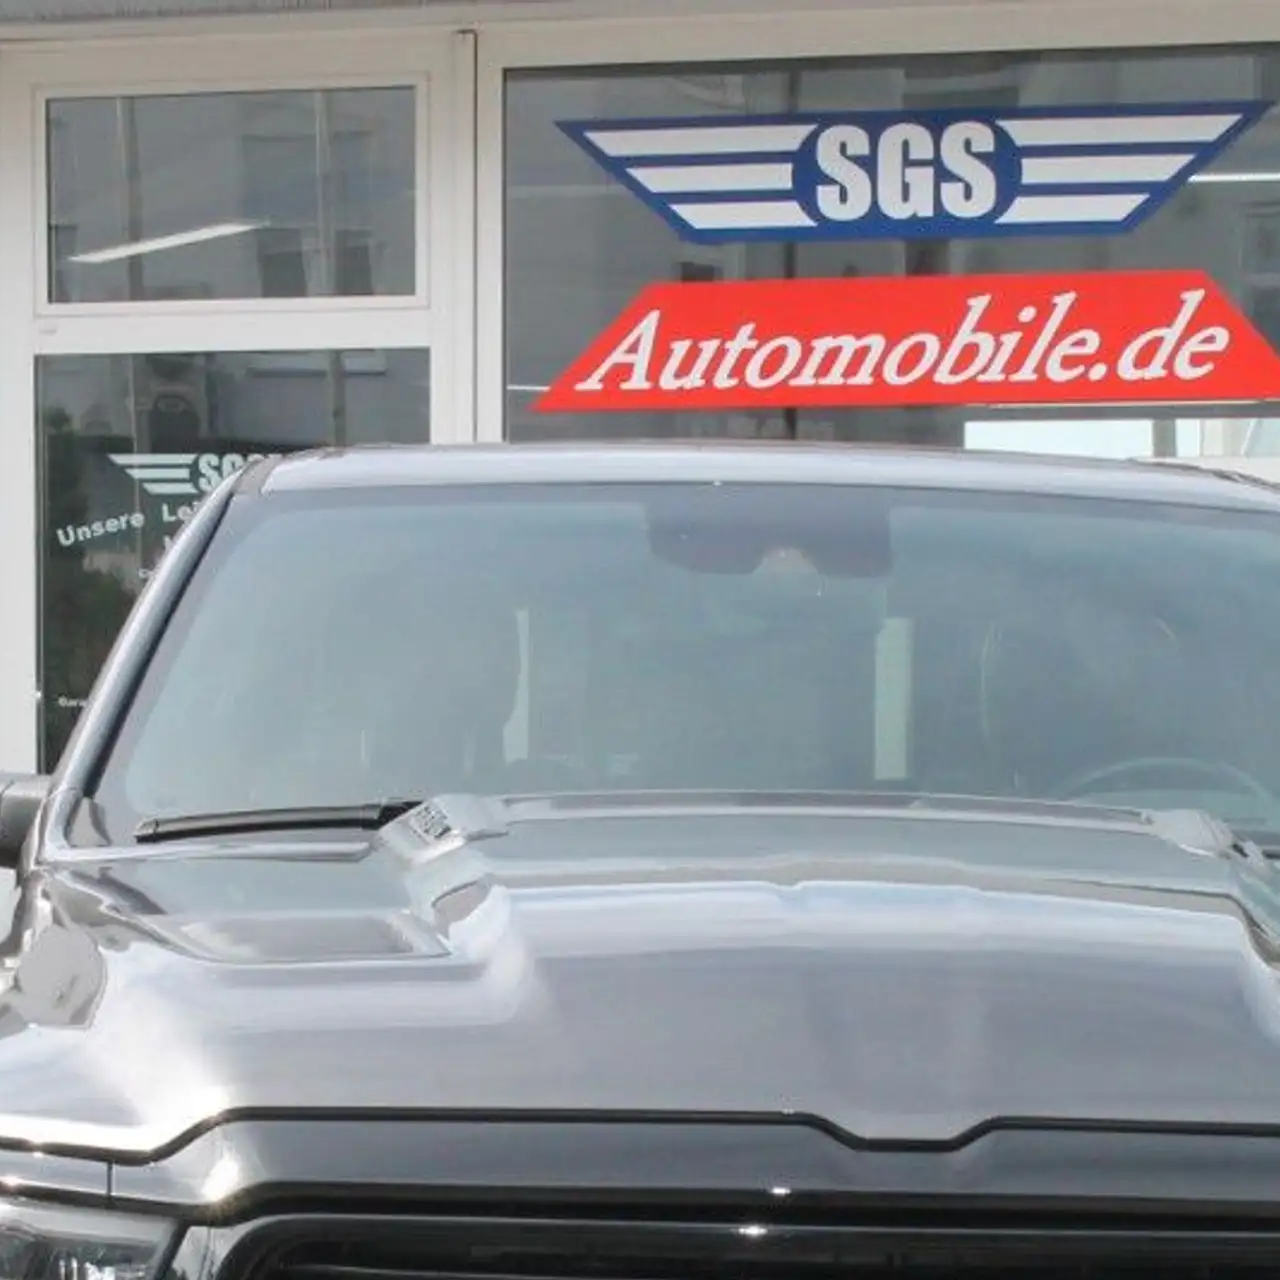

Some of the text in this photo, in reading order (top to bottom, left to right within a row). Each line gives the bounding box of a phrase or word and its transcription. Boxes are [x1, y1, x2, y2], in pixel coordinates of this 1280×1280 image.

[814, 120, 998, 222] SGS
[573, 287, 1231, 393] Automobile.de
[56, 511, 145, 547] Unsere
